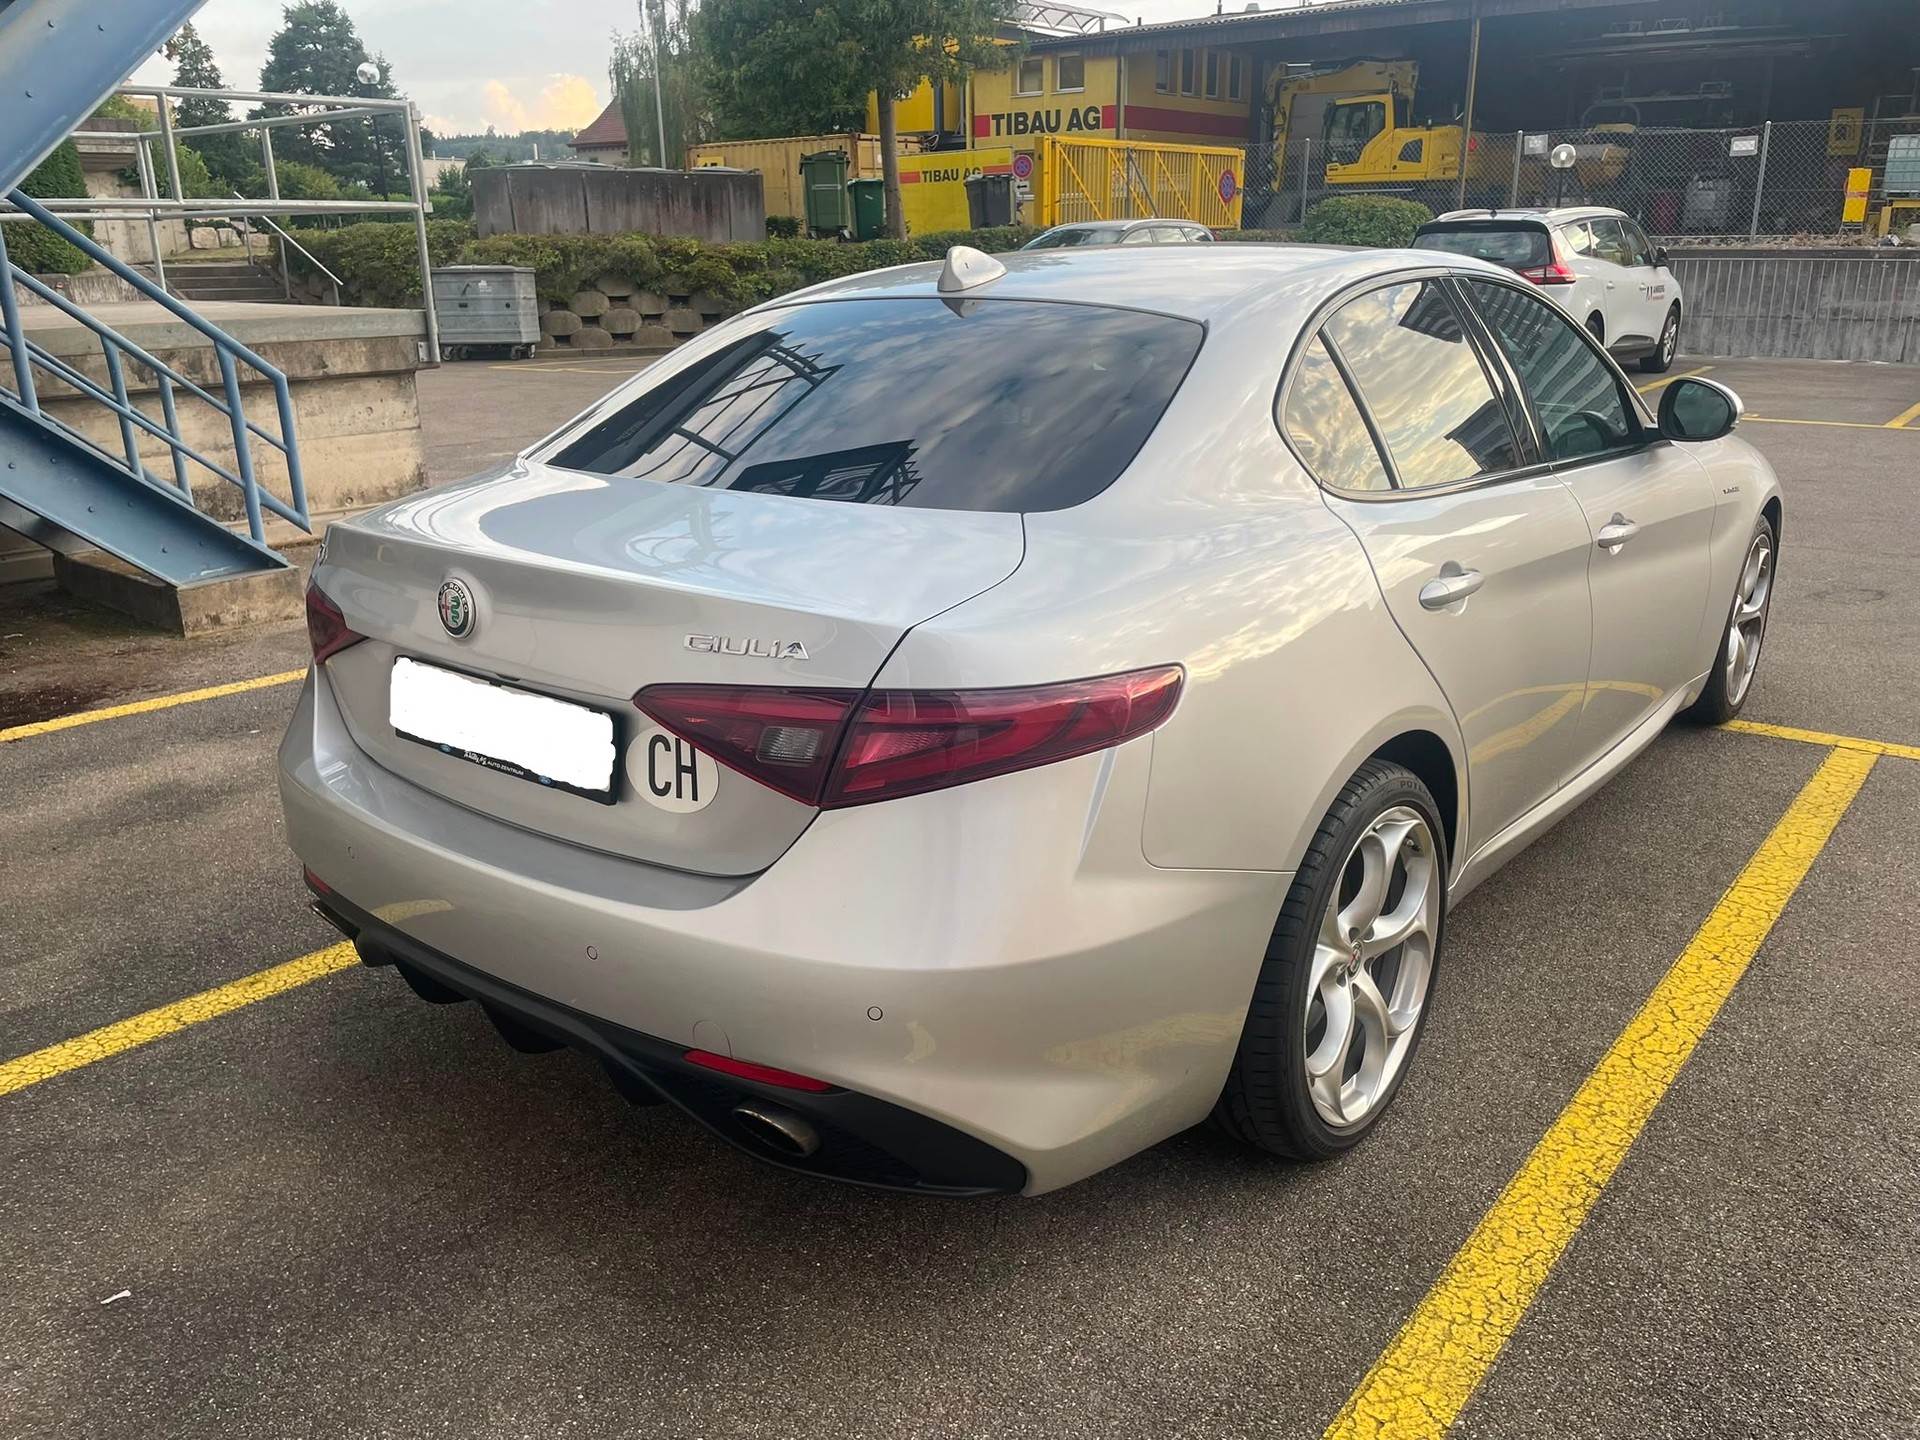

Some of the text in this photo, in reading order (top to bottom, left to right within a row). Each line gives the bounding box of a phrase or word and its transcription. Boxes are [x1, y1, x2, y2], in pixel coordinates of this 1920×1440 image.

[992, 106, 1100, 136] TIBAU AG
[922, 168, 959, 183] TIBAU
[683, 633, 810, 660] GIULIA
[648, 734, 698, 801] CH
